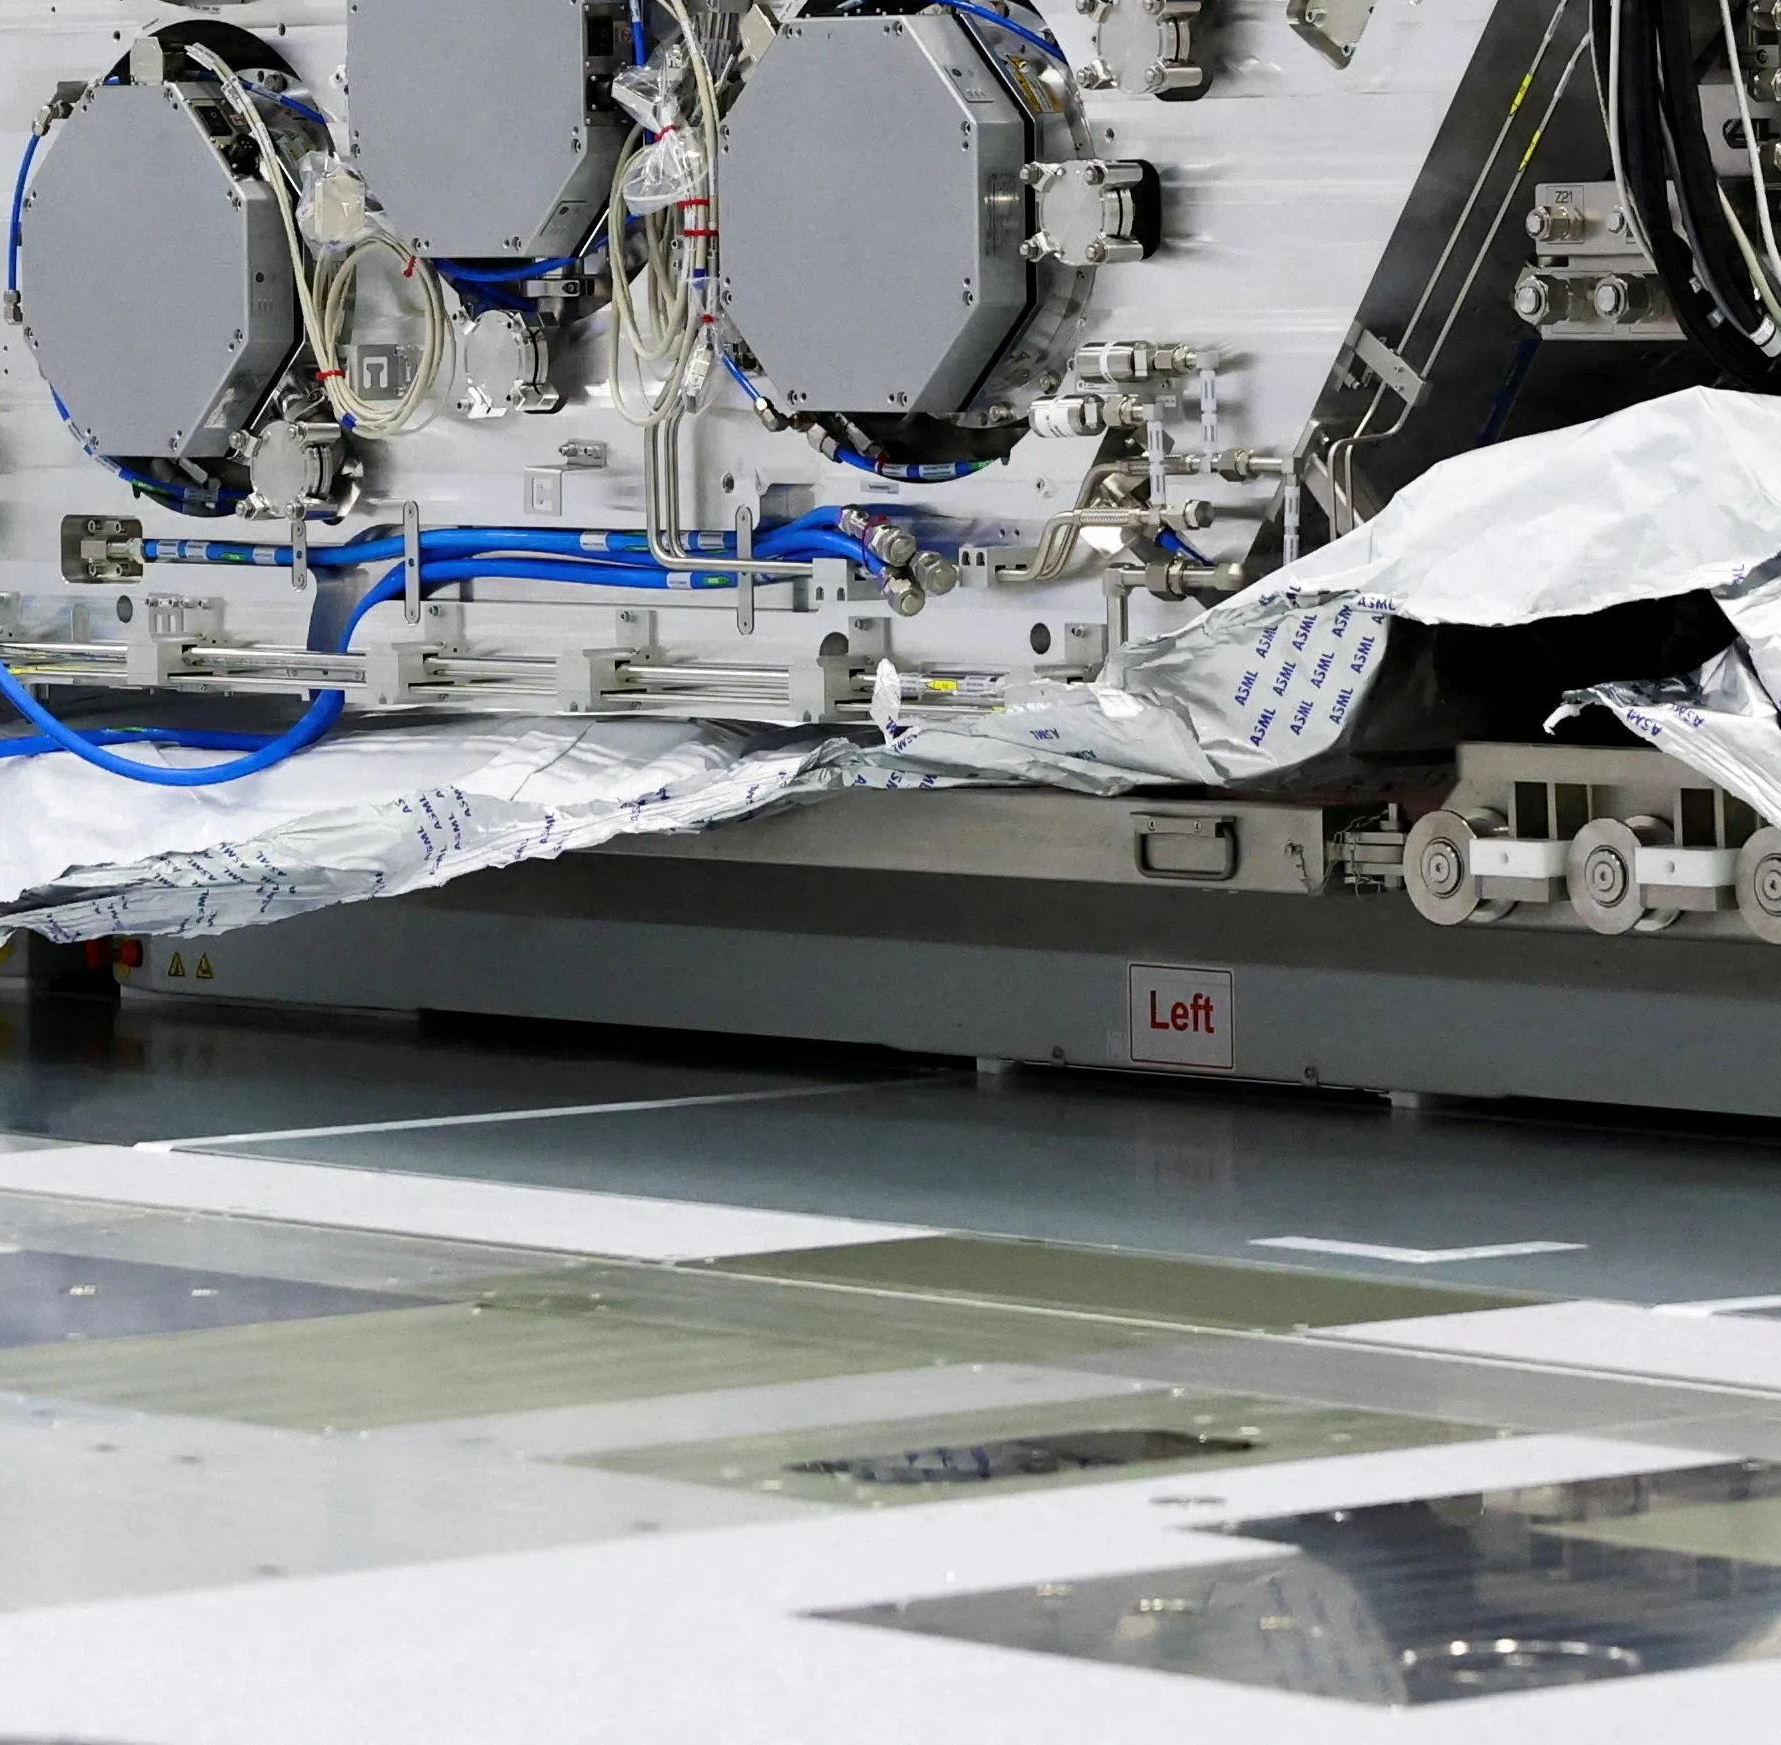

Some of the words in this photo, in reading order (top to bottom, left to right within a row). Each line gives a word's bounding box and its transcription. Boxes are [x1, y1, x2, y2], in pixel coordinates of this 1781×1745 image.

[1554, 191, 1573, 204] Z21
[1332, 605, 1353, 639] ASM
[1357, 597, 1397, 611] ASML
[1255, 624, 1278, 659] ASML
[1292, 614, 1318, 652] ASML
[1310, 652, 1336, 689] ASML
[1350, 636, 1375, 674] ASML
[1234, 670, 1259, 706] ASML
[1272, 661, 1297, 697] ASML
[1289, 701, 1314, 736] ASML
[1329, 688, 1354, 725] ASML
[1626, 708, 1664, 736] ASML
[1250, 708, 1276, 747] ASML
[419, 793, 443, 831] ASML
[450, 785, 472, 818] ASM
[1149, 990, 1215, 1034] Left
